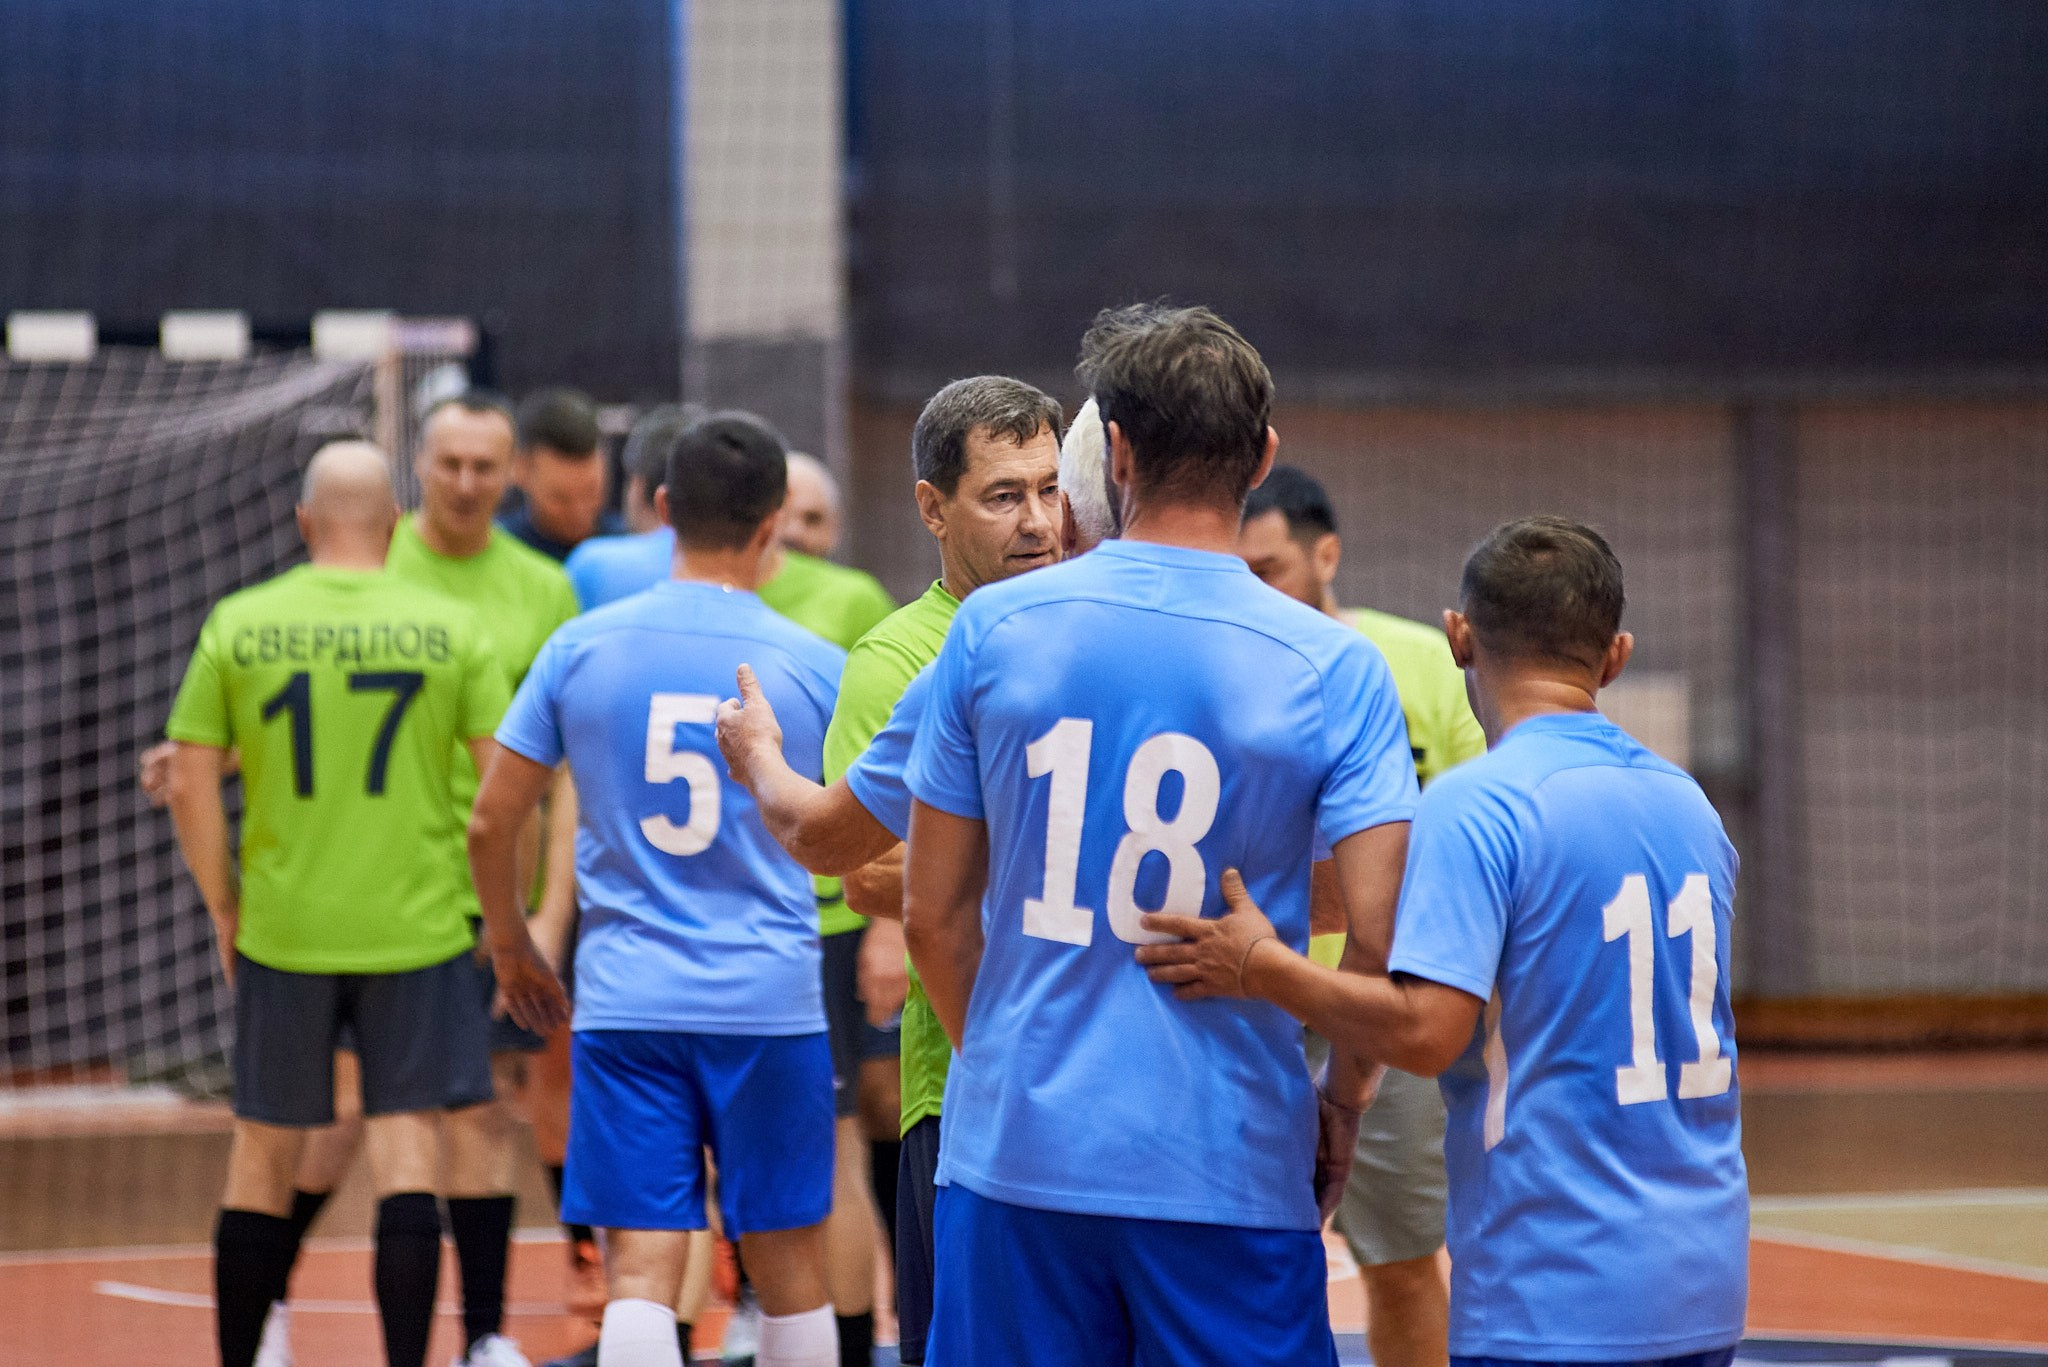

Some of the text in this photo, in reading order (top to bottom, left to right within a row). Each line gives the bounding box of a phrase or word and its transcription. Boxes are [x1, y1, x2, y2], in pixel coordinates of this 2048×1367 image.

[232, 622, 452, 668] СВЕРДЛОВ
[261, 671, 426, 799] 17
[639, 692, 721, 857] 5
[1022, 717, 1221, 947] 18
[1602, 872, 1732, 1106] 11
